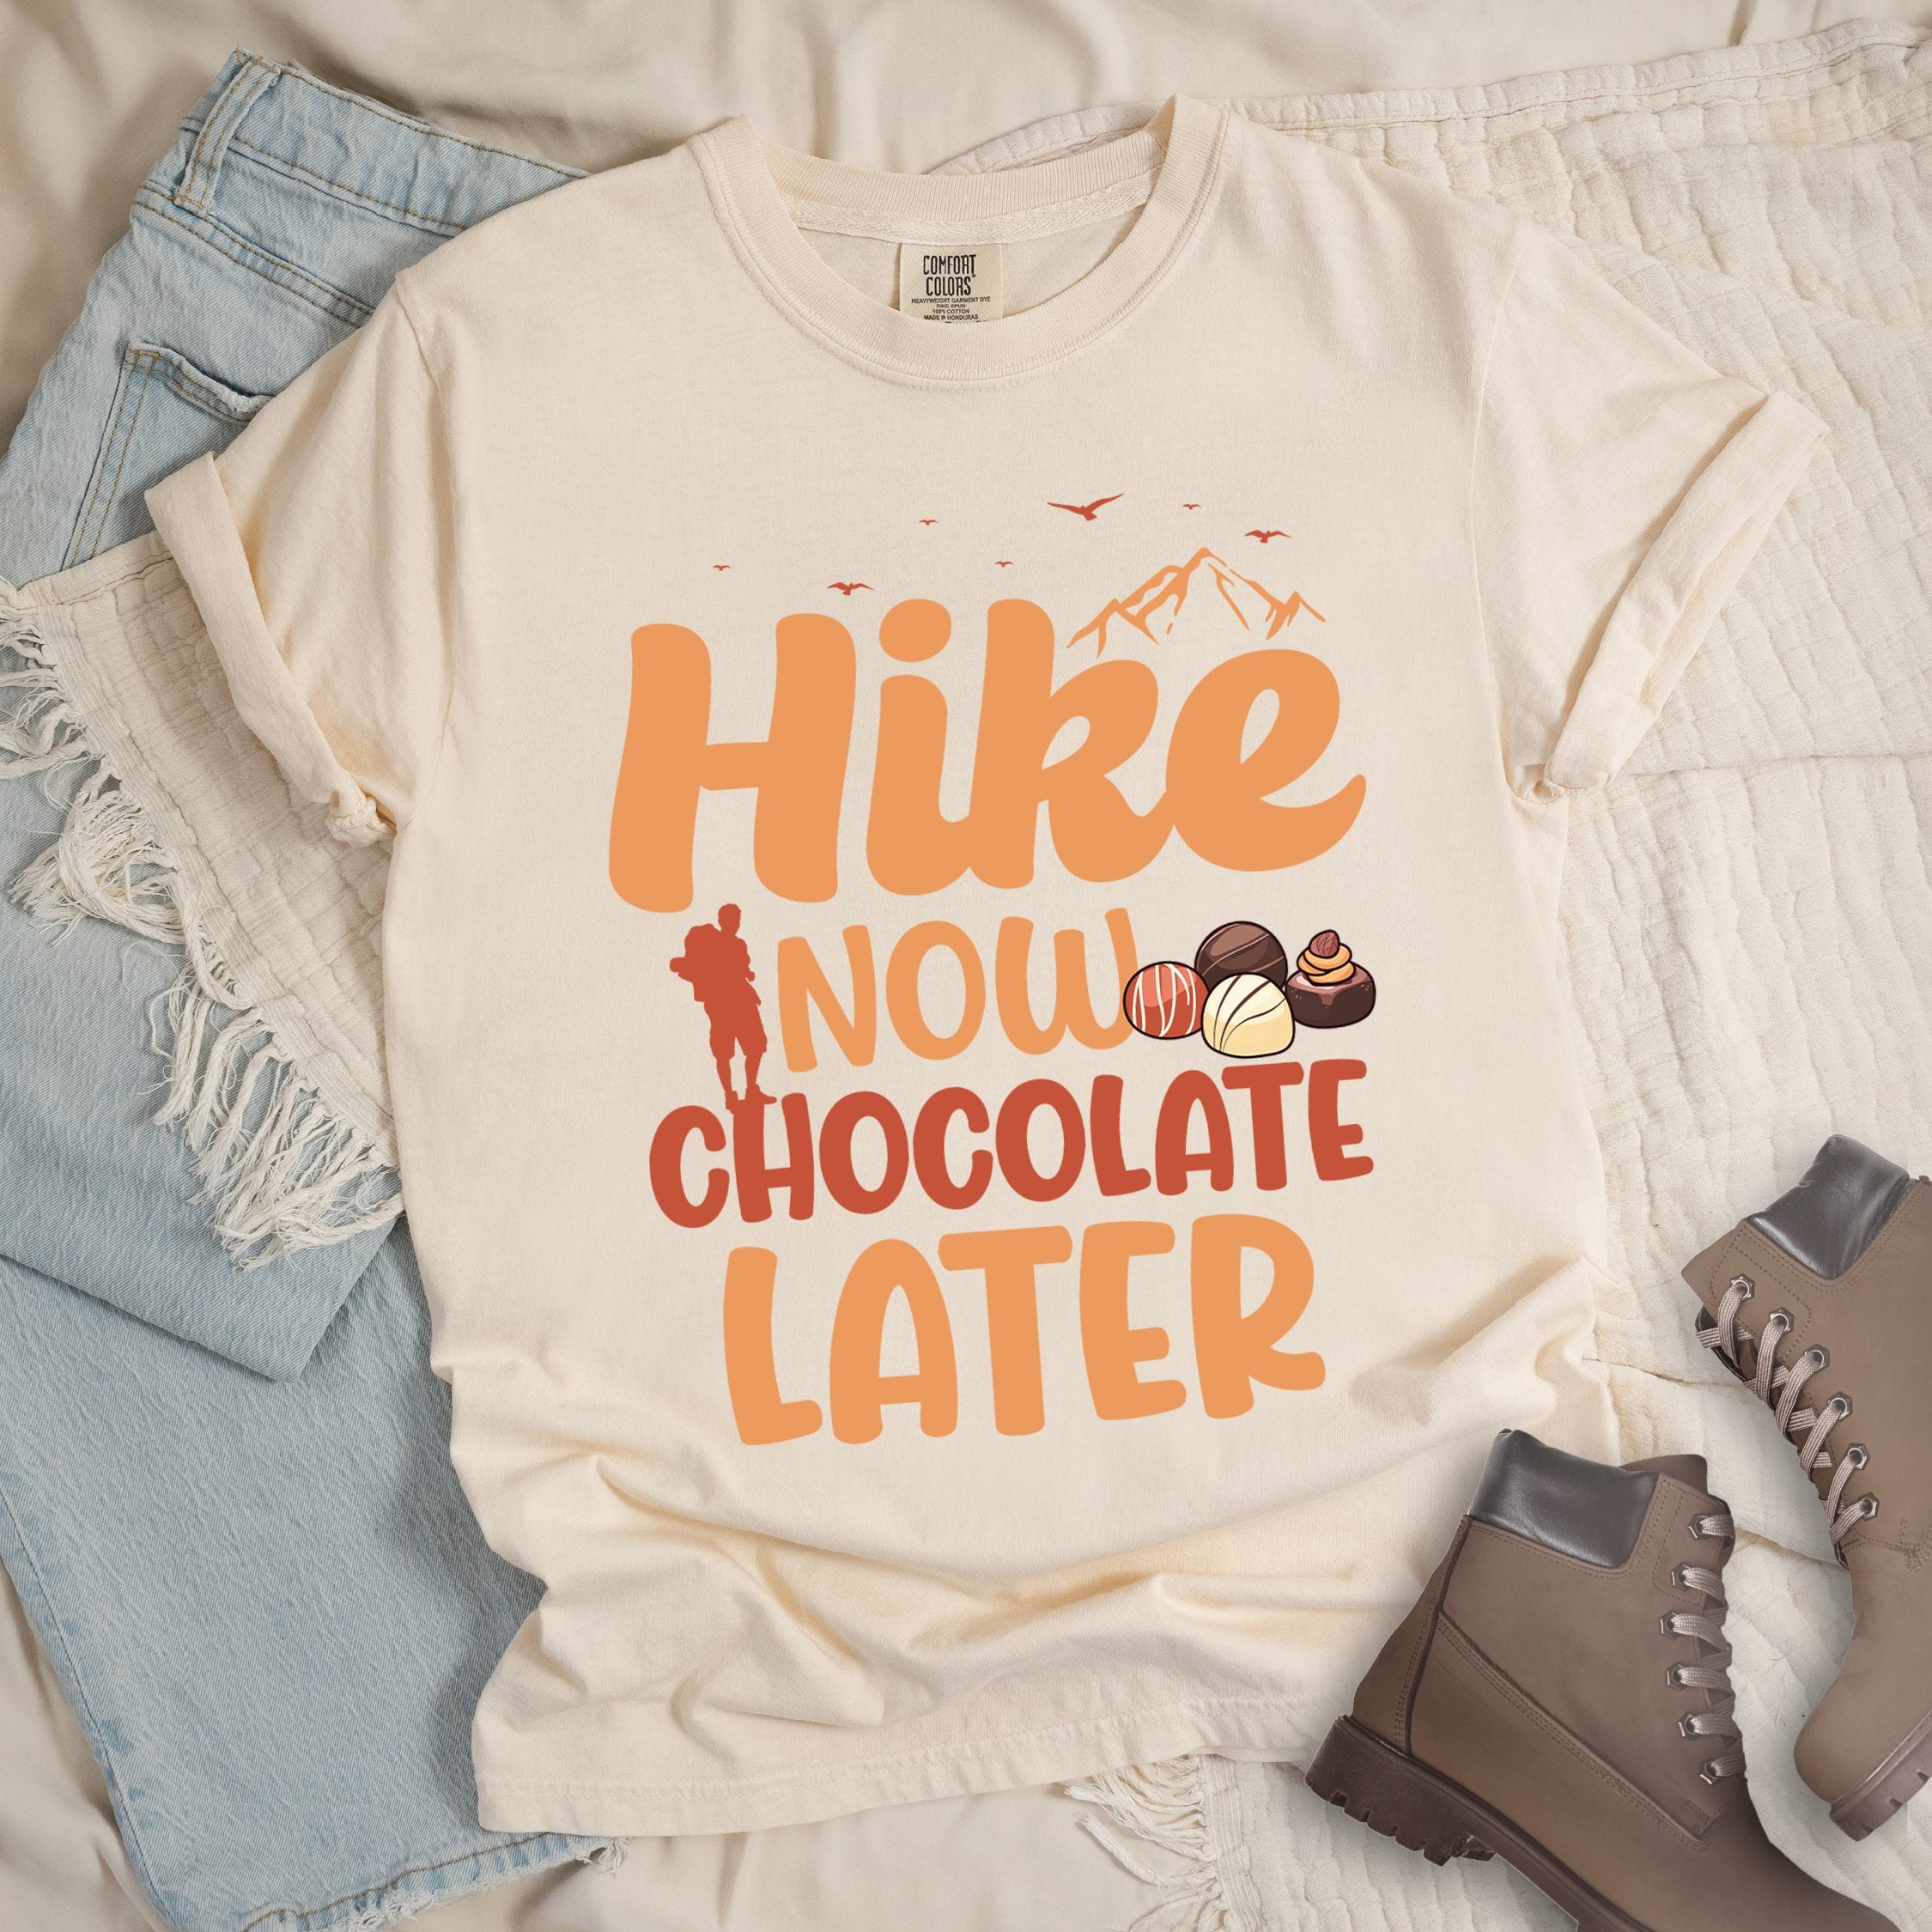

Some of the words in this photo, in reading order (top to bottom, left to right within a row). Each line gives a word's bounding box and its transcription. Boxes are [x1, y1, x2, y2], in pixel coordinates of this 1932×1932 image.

[923, 254, 976, 275] COMFORT
[610, 599, 1365, 912] Hike
[777, 908, 1139, 1072] NOW
[649, 1060, 1374, 1228] CHOCOLATE
[724, 1215, 1326, 1445] LATER
